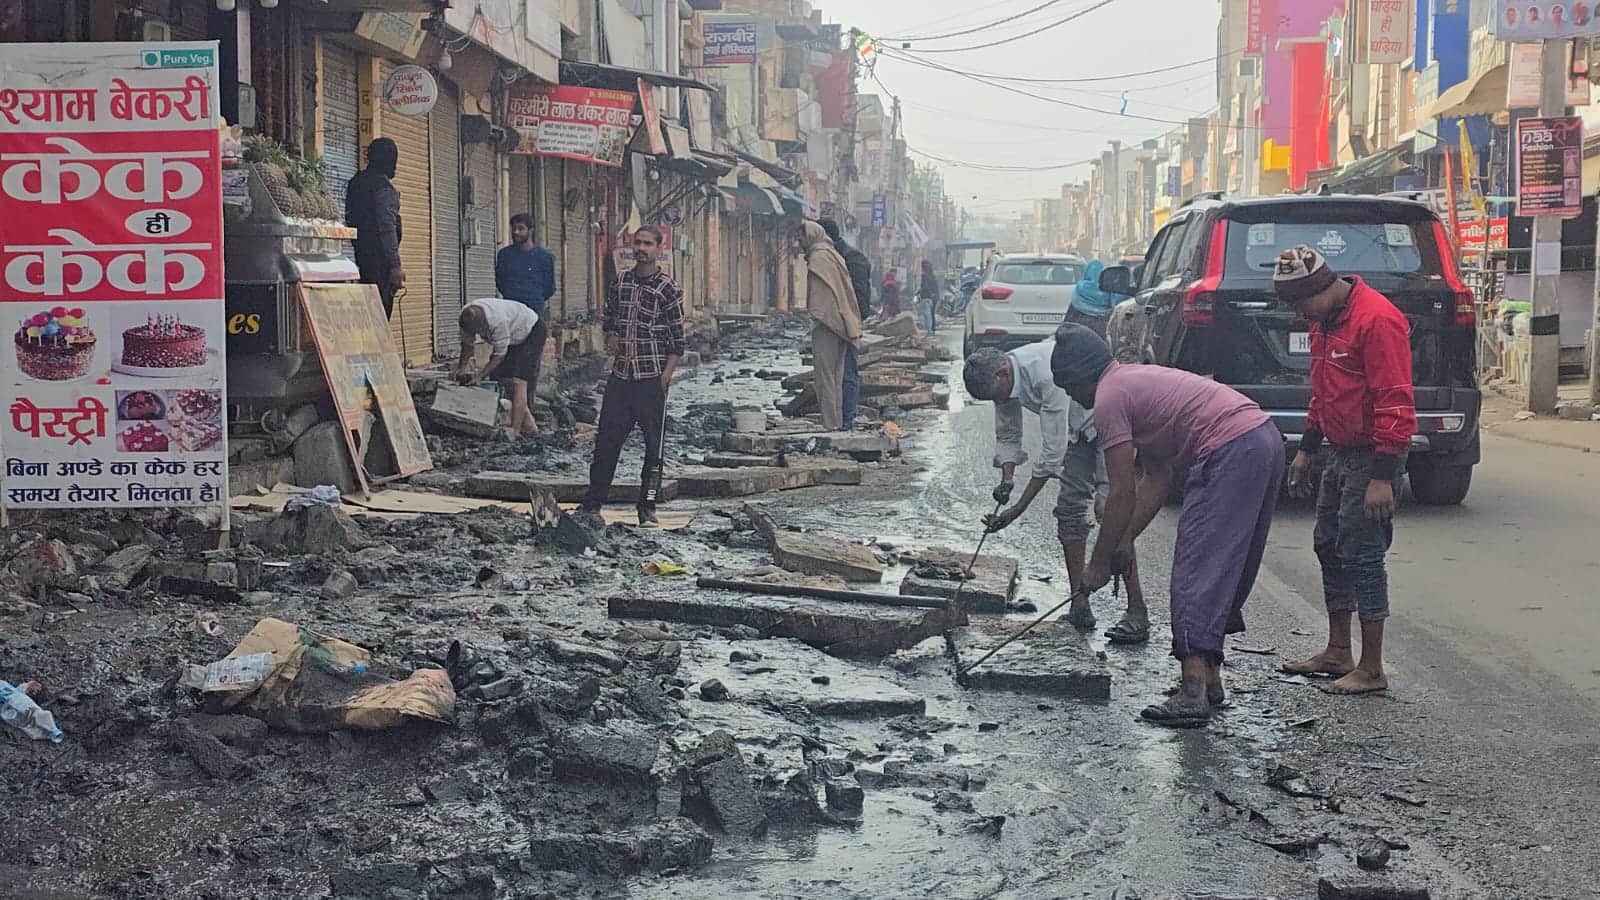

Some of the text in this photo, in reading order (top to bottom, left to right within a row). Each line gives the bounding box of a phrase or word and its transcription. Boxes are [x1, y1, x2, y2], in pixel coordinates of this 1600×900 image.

[163, 53, 188, 64] Pure
[0, 75, 211, 125] श्याम बेकरी
[551, 101, 577, 119] लाल
[577, 98, 605, 121] शंकर
[606, 106, 631, 126] लाल
[1521, 143, 1554, 153] Fashion
[1, 137, 210, 204] केक
[145, 212, 170, 234] ही
[4, 228, 212, 296] केक
[9, 396, 109, 446] पैस्ट्री
[6, 457, 222, 477] बिना अण्डे का केक हर
[7, 487, 62, 503] समय
[67, 484, 122, 503] तैयार
[127, 482, 193, 502] मिलता
